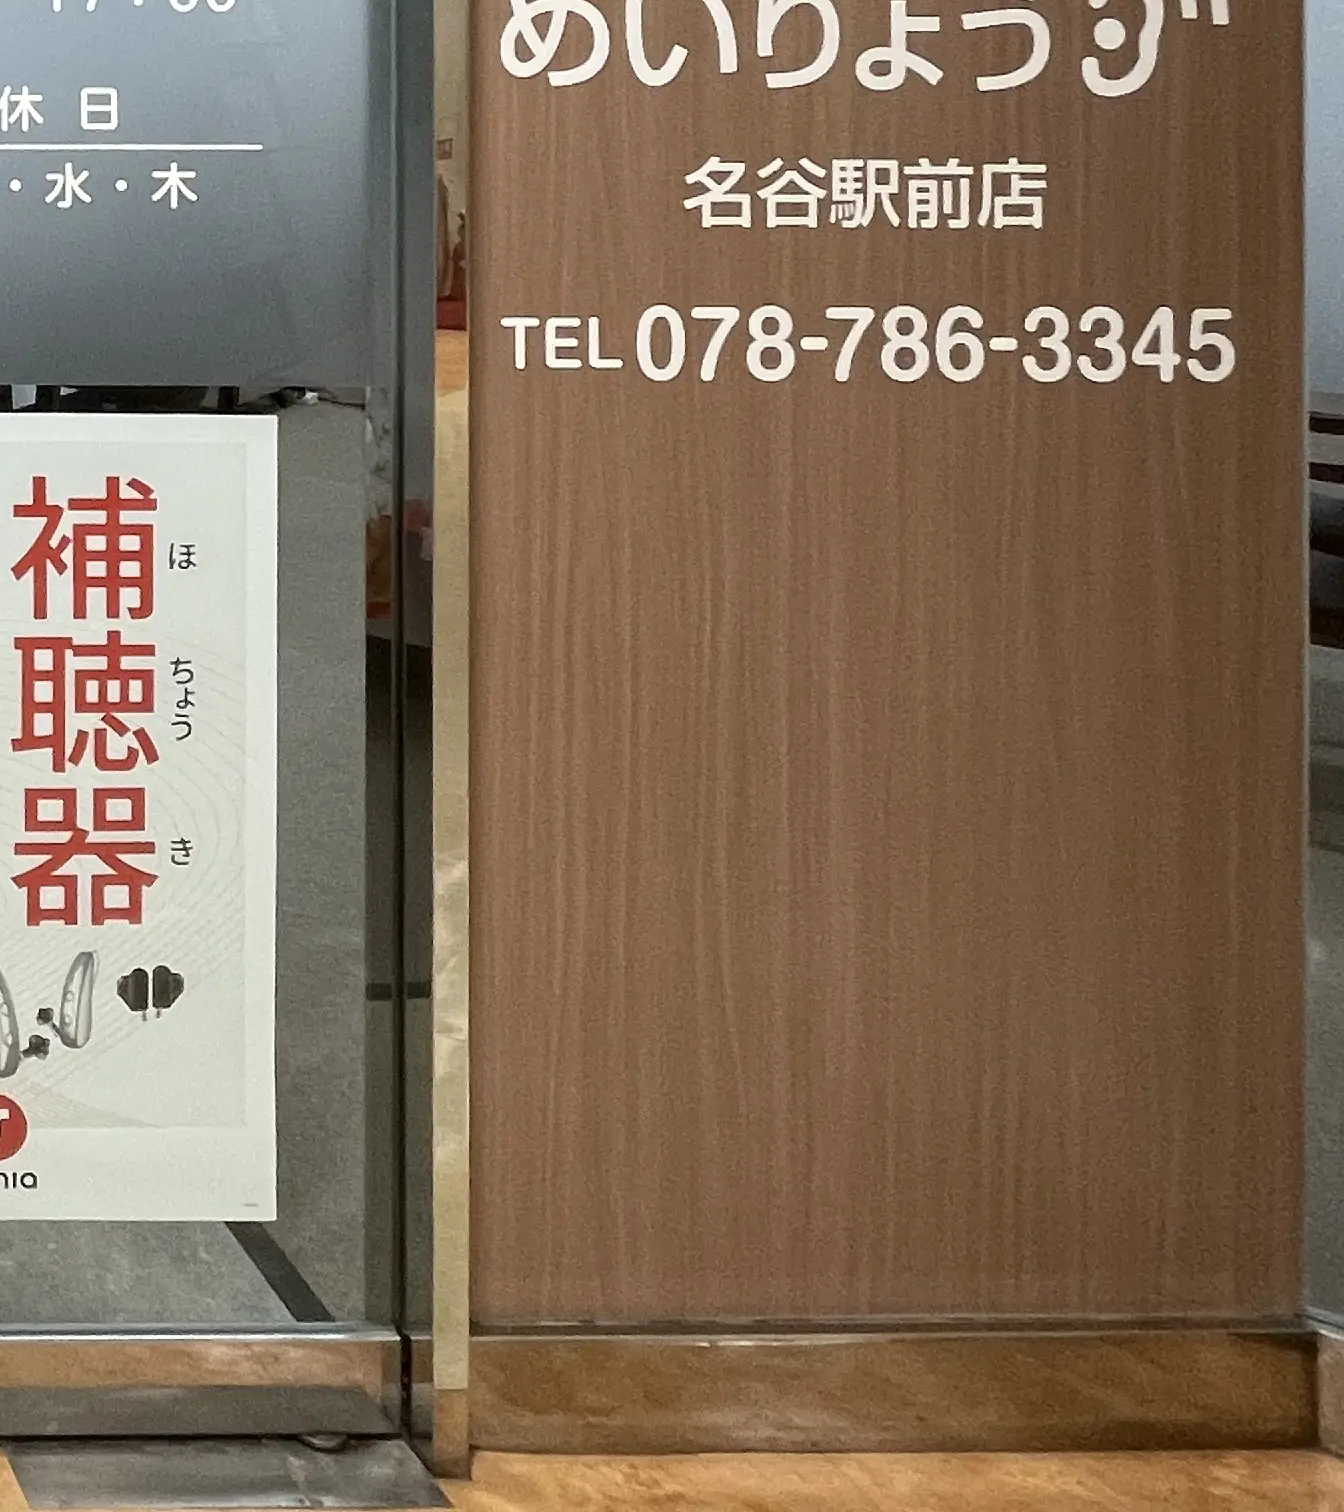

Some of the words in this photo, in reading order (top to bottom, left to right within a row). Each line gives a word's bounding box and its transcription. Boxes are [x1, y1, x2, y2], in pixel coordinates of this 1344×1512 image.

[682, 156, 1048, 230] 名谷駅前店
[500, 314, 624, 371] TEL
[634, 303, 1237, 384] 078-786-3345
[168, 541, 198, 570] ほ
[10, 475, 159, 927] 補聴器
[169, 656, 197, 741] ちょう
[169, 836, 194, 867] き
